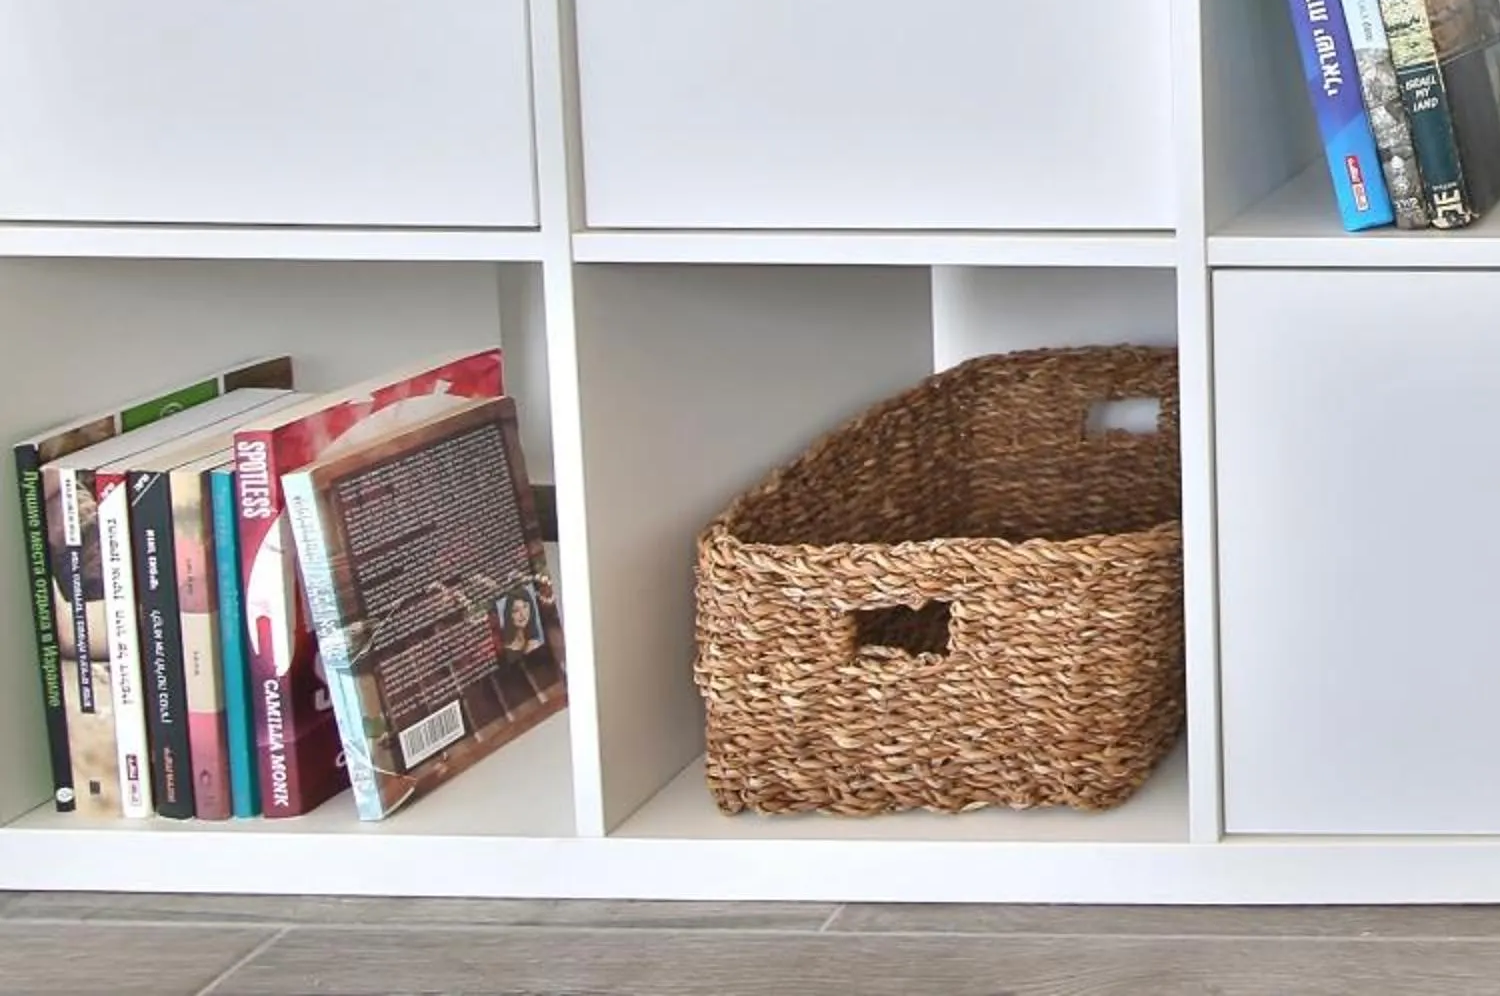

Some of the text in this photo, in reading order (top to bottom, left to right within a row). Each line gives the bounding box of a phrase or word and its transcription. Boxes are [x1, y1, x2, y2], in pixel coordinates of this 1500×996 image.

[1312, 25, 1345, 98] ישראלי
[1404, 73, 1437, 91] ISRAEL
[1411, 95, 1440, 113] LAND
[1414, 84, 1432, 100] MY
[22, 469, 40, 527] Лучшие
[237, 440, 271, 519] SPOTLESS
[29, 529, 45, 575] места
[34, 577, 52, 631] отдыха
[41, 644, 62, 709] Израиле
[264, 679, 289, 807] CAMILLA MONK
